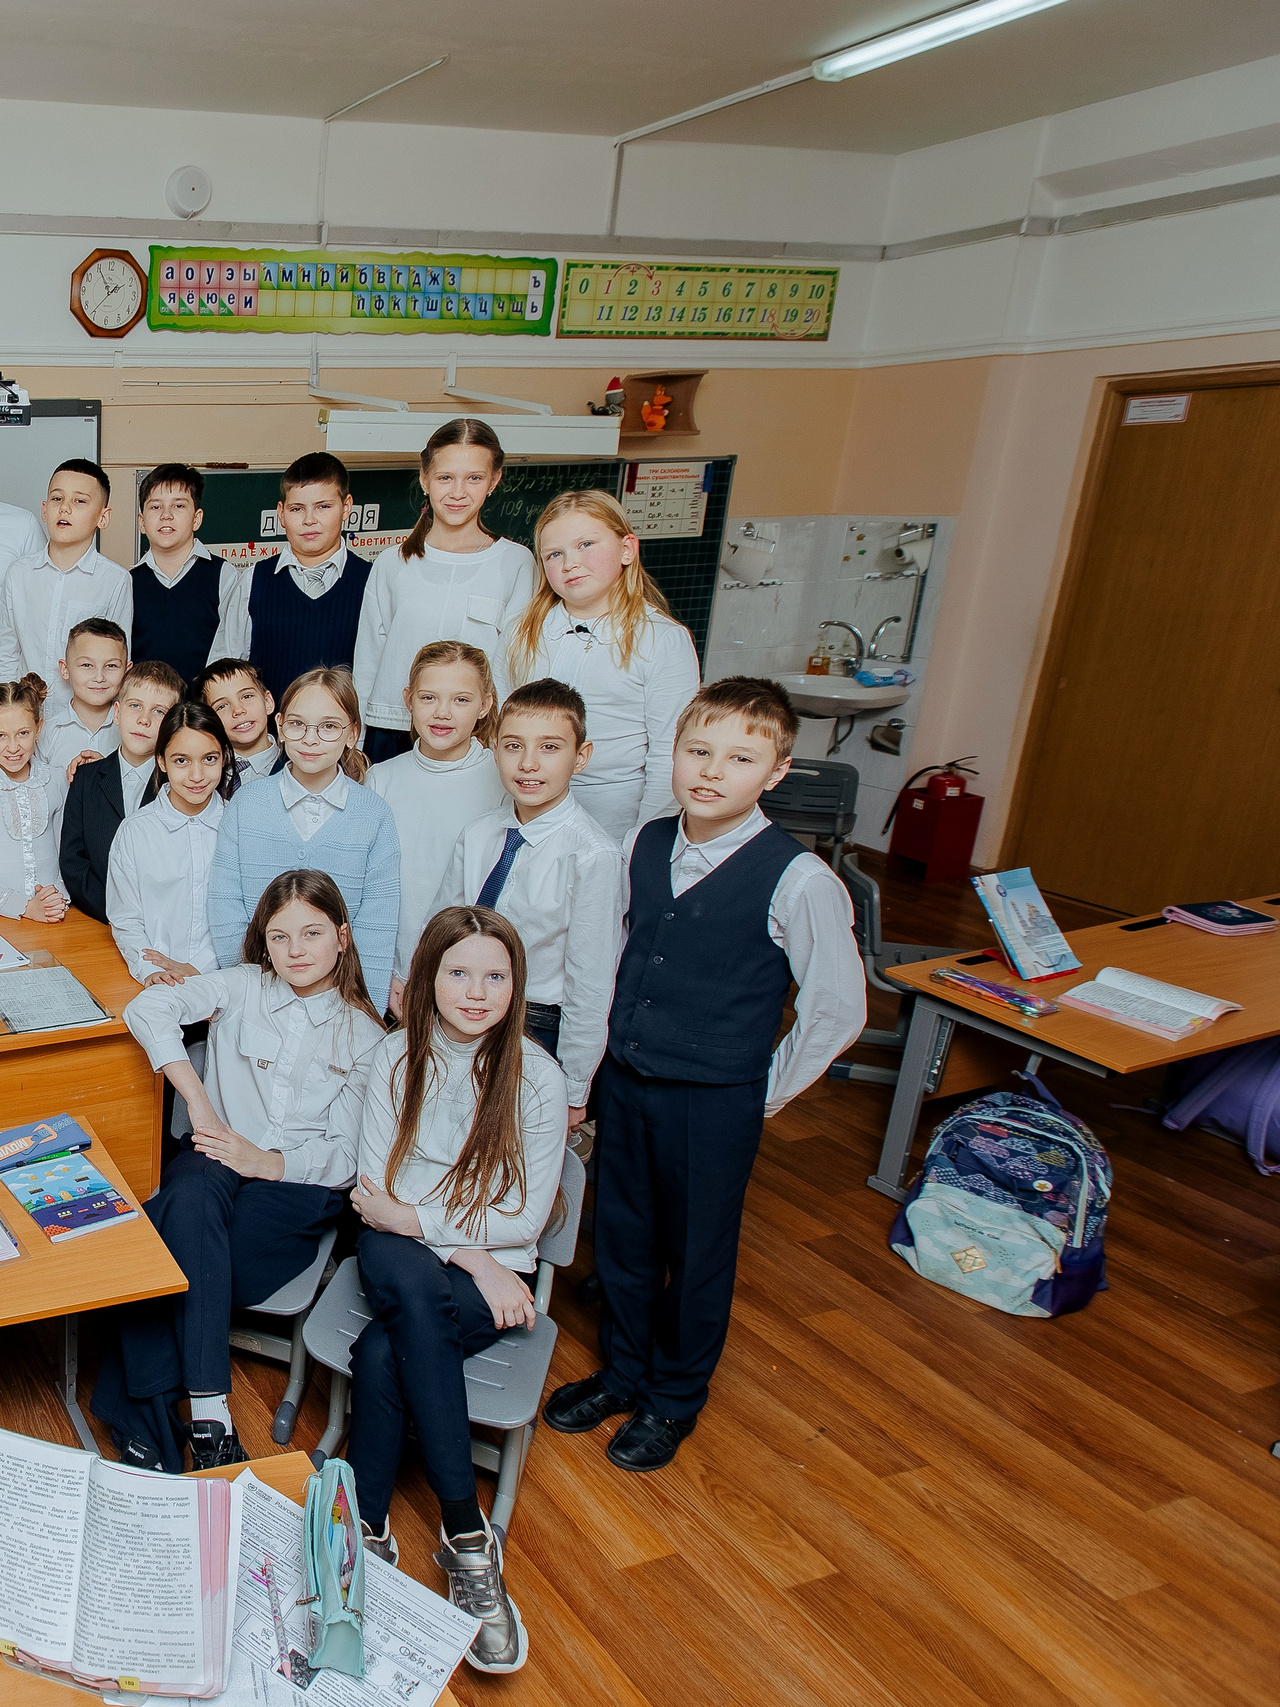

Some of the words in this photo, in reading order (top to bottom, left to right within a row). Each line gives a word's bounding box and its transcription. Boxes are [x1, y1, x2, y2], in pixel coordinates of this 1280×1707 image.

[109, 261, 115, 271] 12
[122, 267, 125, 275] 1
[86, 273, 92, 282] 10
[165, 266, 174, 280] а
[185, 267, 195, 280] о
[206, 267, 214, 284] у
[225, 267, 234, 281] э
[243, 268, 255, 281] ы
[264, 269, 273, 282] л
[281, 269, 292, 282] м
[302, 270, 310, 282] н
[321, 269, 329, 286] р
[340, 266, 349, 283] й
[359, 264, 367, 284] б
[377, 272, 385, 283] в
[396, 272, 402, 284] г
[412, 272, 421, 287] д
[428, 273, 440, 285] ж
[448, 273, 455, 285] з
[532, 276, 540, 288] ъ
[129, 277, 133, 287] 2
[81, 286, 86, 295] 9
[579, 278, 589, 294] 0
[604, 280, 612, 295] 1
[627, 280, 639, 295] 2
[651, 280, 662, 295] 3
[675, 281, 685, 295] 4
[698, 281, 710, 296] 5
[722, 282, 732, 297] 6
[745, 282, 756, 297] 7
[767, 283, 777, 298] 8
[789, 283, 799, 298] 9
[809, 284, 825, 299] 10
[131, 291, 136, 301] 3
[85, 301, 89, 310] 8
[168, 292, 175, 303] я
[187, 290, 195, 304] ё
[207, 293, 218, 304] ю
[227, 293, 235, 304] е
[244, 296, 252, 308] и
[357, 299, 365, 310] п
[374, 296, 384, 314] ф
[393, 299, 401, 311] к
[412, 300, 419, 311] т
[426, 300, 438, 311] ш
[445, 300, 453, 311] с
[463, 300, 471, 312] х
[479, 301, 487, 314] ц
[497, 301, 505, 313] ч
[511, 301, 523, 315] щ
[530, 302, 538, 313] ь
[126, 305, 130, 314] 4
[596, 305, 613, 321] 11
[621, 305, 639, 321] 12
[645, 307, 662, 321] 13
[668, 307, 685, 322] 14
[690, 308, 707, 322] 15
[715, 308, 732, 322] 16
[737, 308, 756, 322] 17
[760, 308, 777, 323] 18
[782, 308, 798, 322] 19
[803, 308, 820, 323] 20
[92, 311, 96, 321] 7
[104, 316, 108, 325] 6
[117, 314, 121, 323] 5
[501, 500, 523, 516] 109
[352, 536, 392, 547] Светит
[221, 547, 278, 558] ПАДЕЖИ
[456, 1616, 475, 1630] класс
